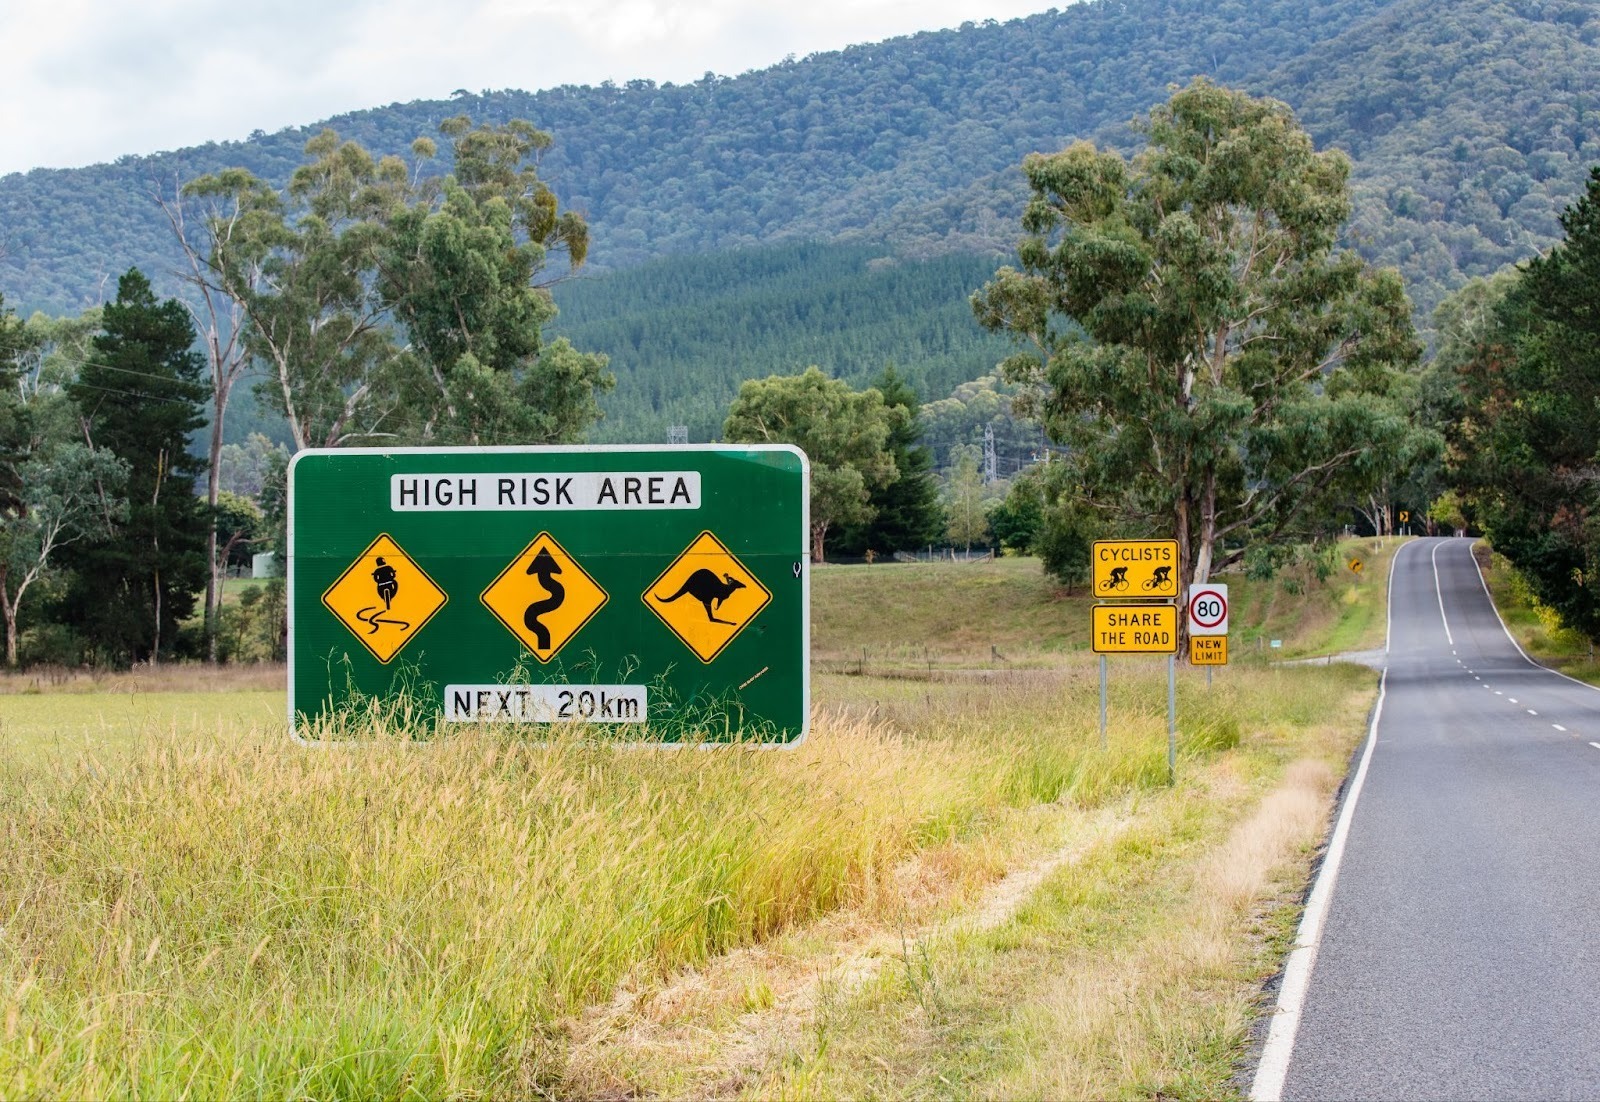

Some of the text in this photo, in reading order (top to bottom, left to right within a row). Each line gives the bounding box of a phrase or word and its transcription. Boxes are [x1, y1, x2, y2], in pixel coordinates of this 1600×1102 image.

[400, 477, 692, 506] HIGH RISK AREA
[1100, 548, 1170, 561] CYCLISTS
[1197, 601, 1220, 617] 80
[1108, 613, 1162, 626] SHARE
[1101, 632, 1169, 644] THE ROAD
[1196, 640, 1221, 648] NEW
[1195, 651, 1223, 660] LIMIT
[454, 690, 639, 718] NEXT 20km
